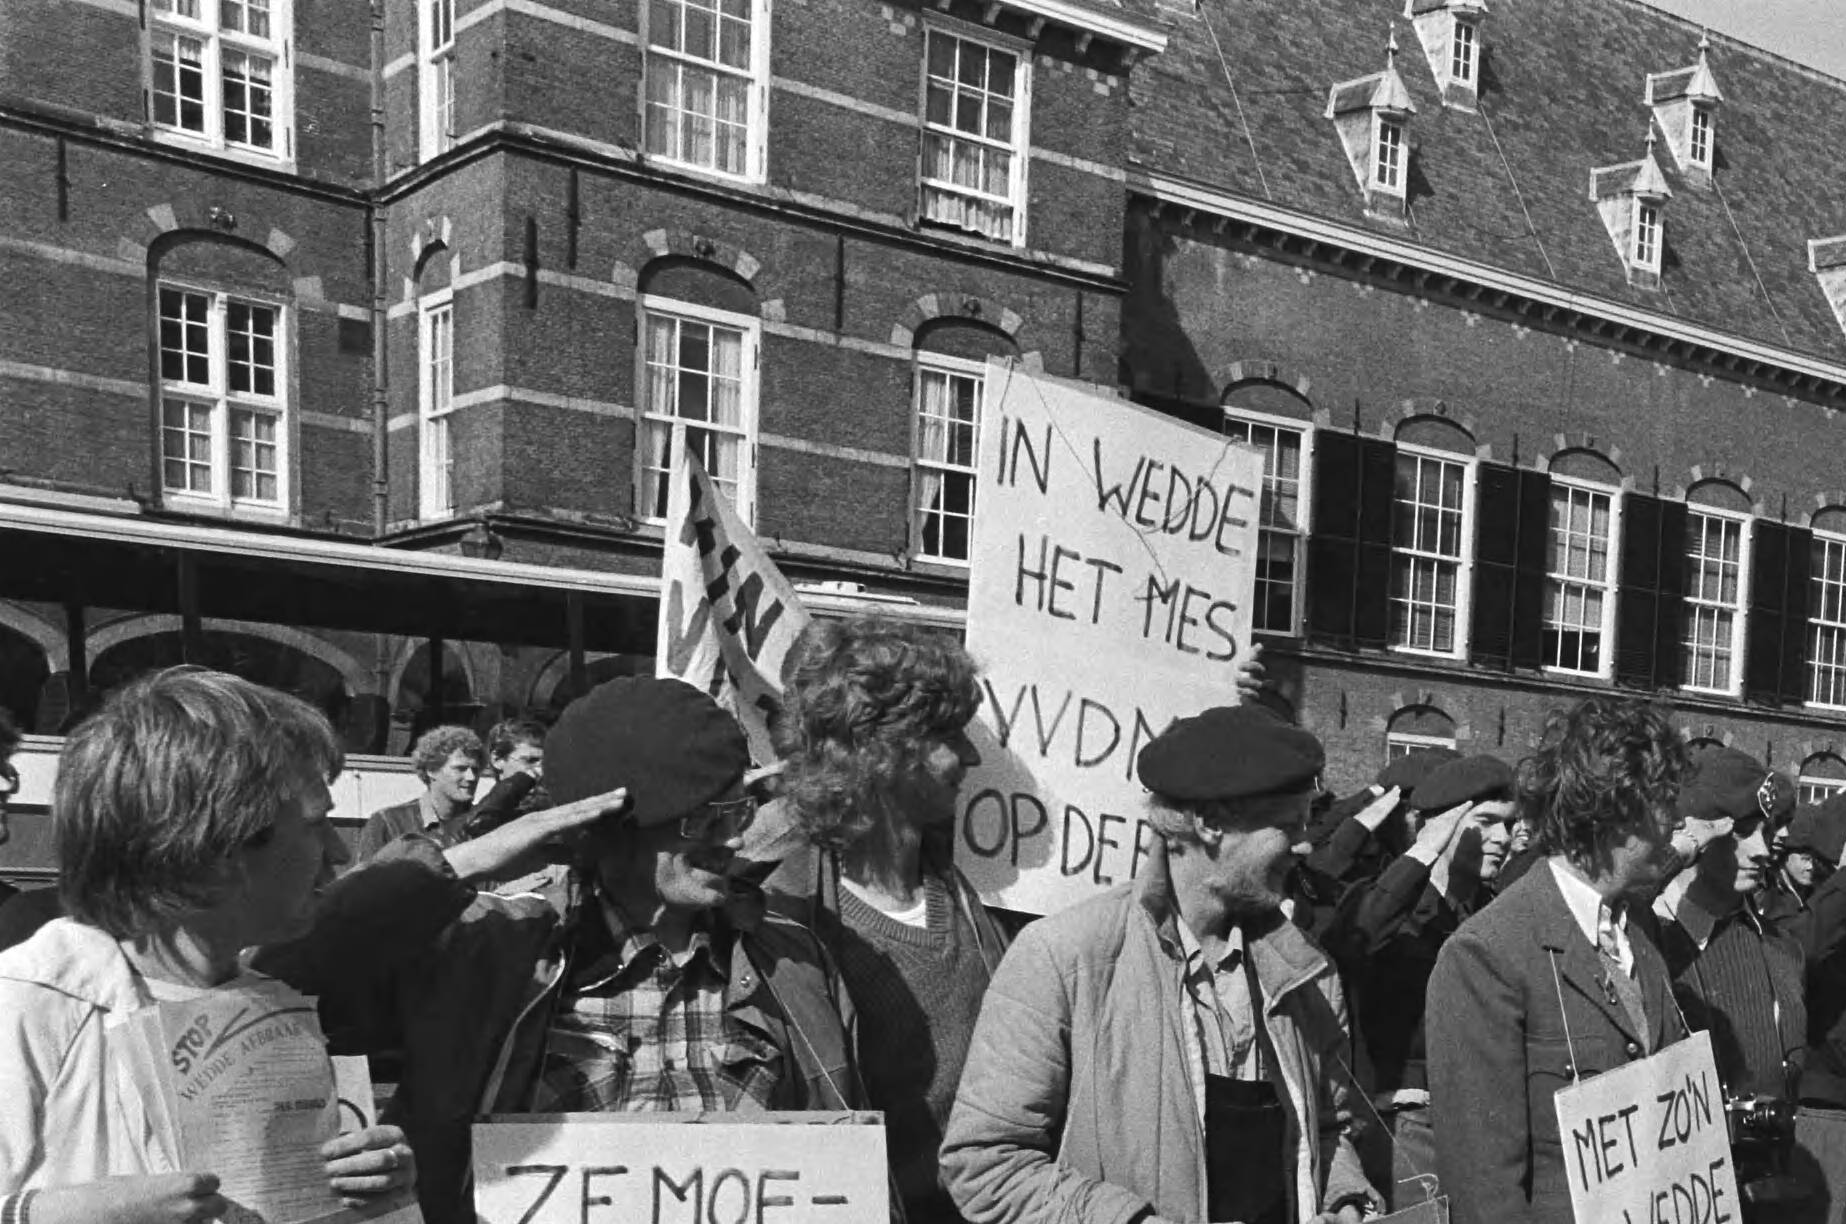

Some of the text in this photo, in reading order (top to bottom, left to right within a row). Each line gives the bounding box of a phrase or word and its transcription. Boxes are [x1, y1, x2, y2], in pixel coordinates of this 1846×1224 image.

[998, 416, 1255, 556] IN WEDDE
[1014, 533, 1238, 662] HET MES
[963, 787, 1049, 868] OP
[171, 1013, 213, 1076] STOP
[1572, 1070, 1712, 1192] MET ZO'N
